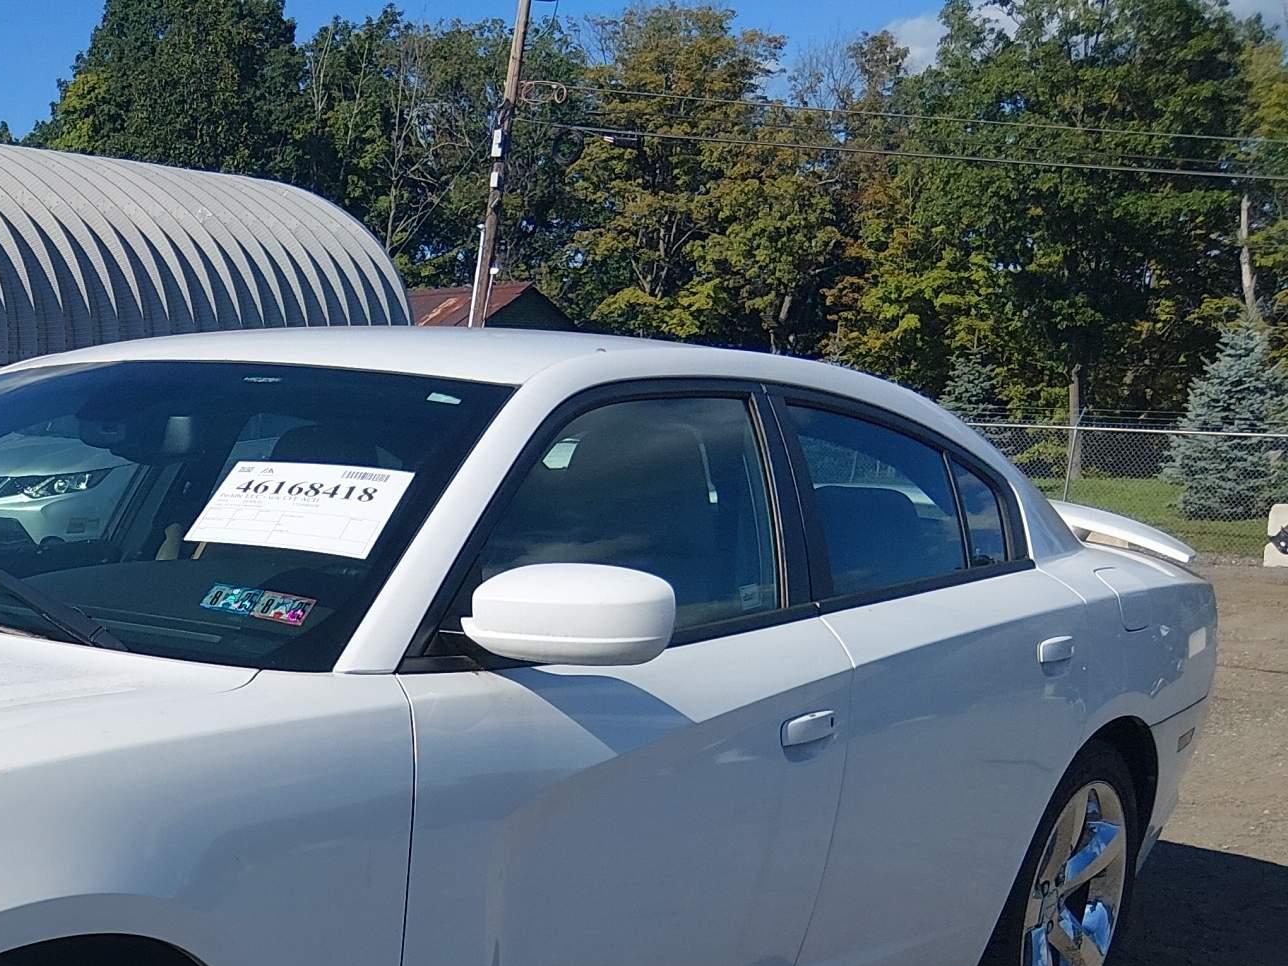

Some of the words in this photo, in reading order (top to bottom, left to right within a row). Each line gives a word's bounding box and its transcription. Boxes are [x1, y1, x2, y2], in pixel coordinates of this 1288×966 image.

[235, 479, 378, 503] 46168418
[210, 590, 224, 606] 8
[261, 598, 275, 614] 8
